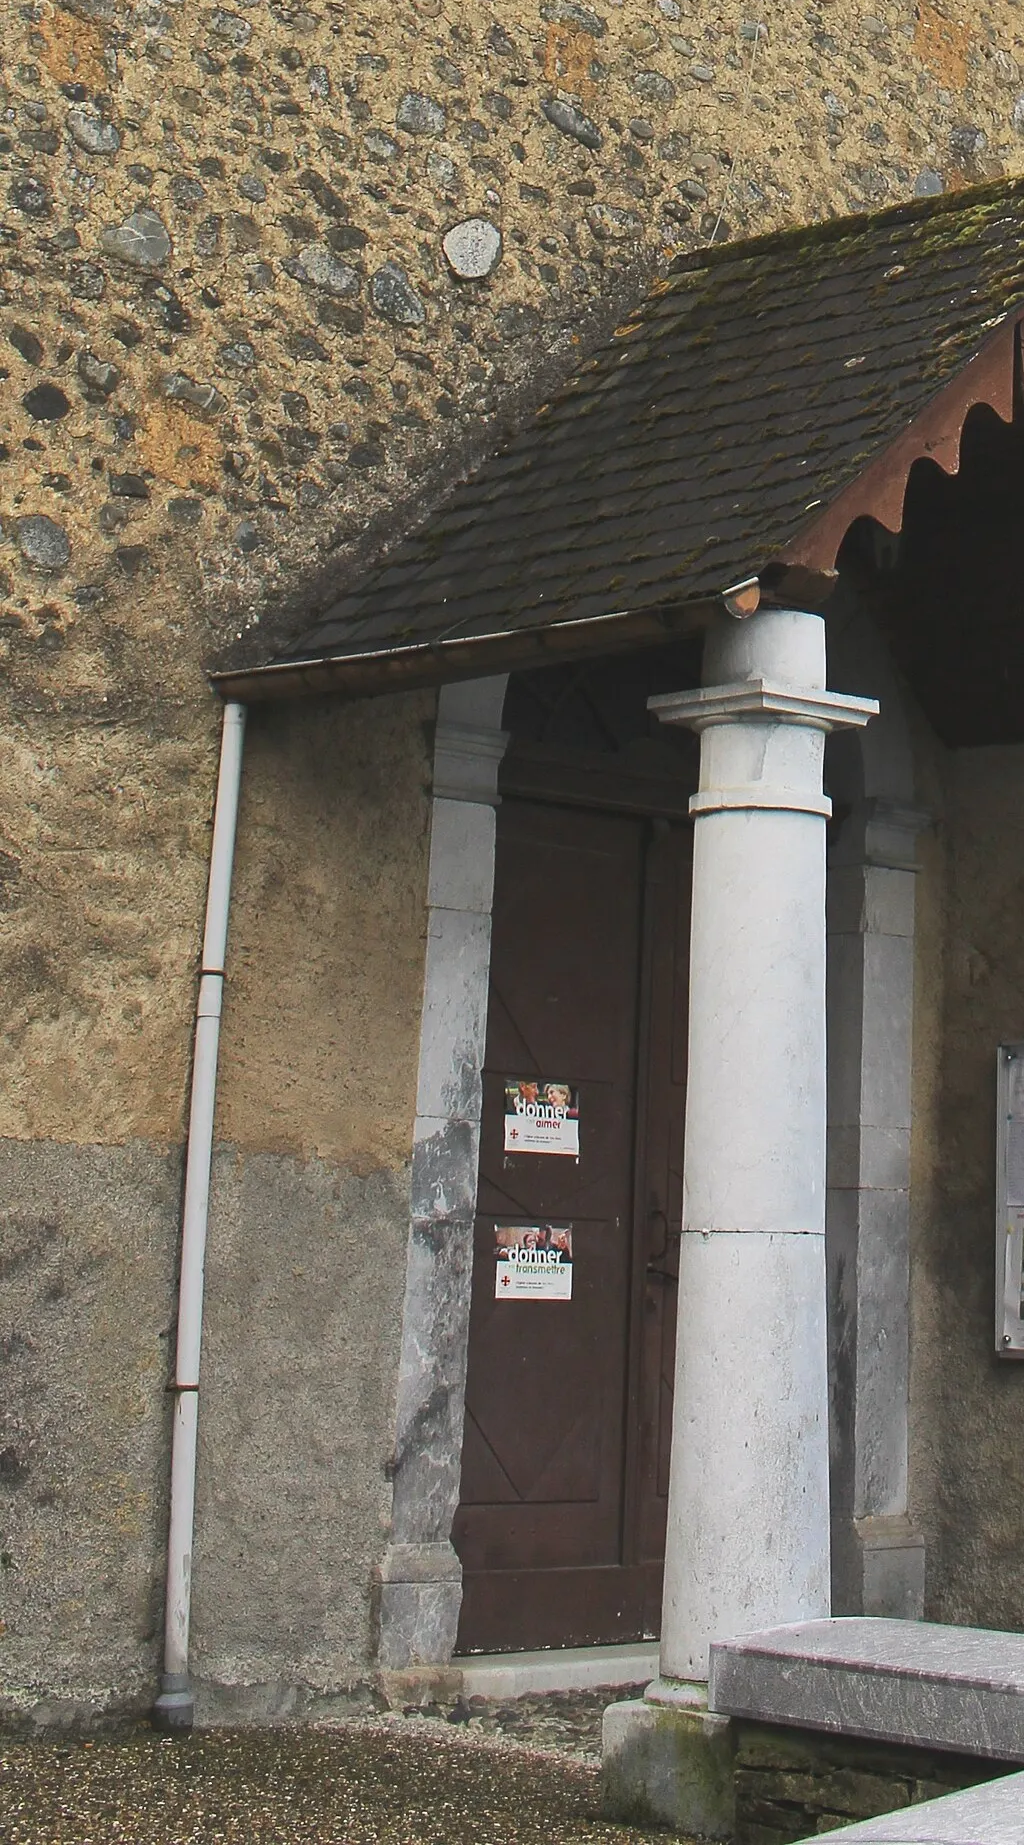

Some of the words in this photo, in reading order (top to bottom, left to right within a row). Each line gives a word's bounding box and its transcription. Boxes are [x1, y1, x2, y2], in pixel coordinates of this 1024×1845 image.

[516, 1097, 570, 1119] donner
[535, 1119, 561, 1129] aimer
[508, 1243, 563, 1263] donner
[515, 1263, 566, 1275] transmettre
